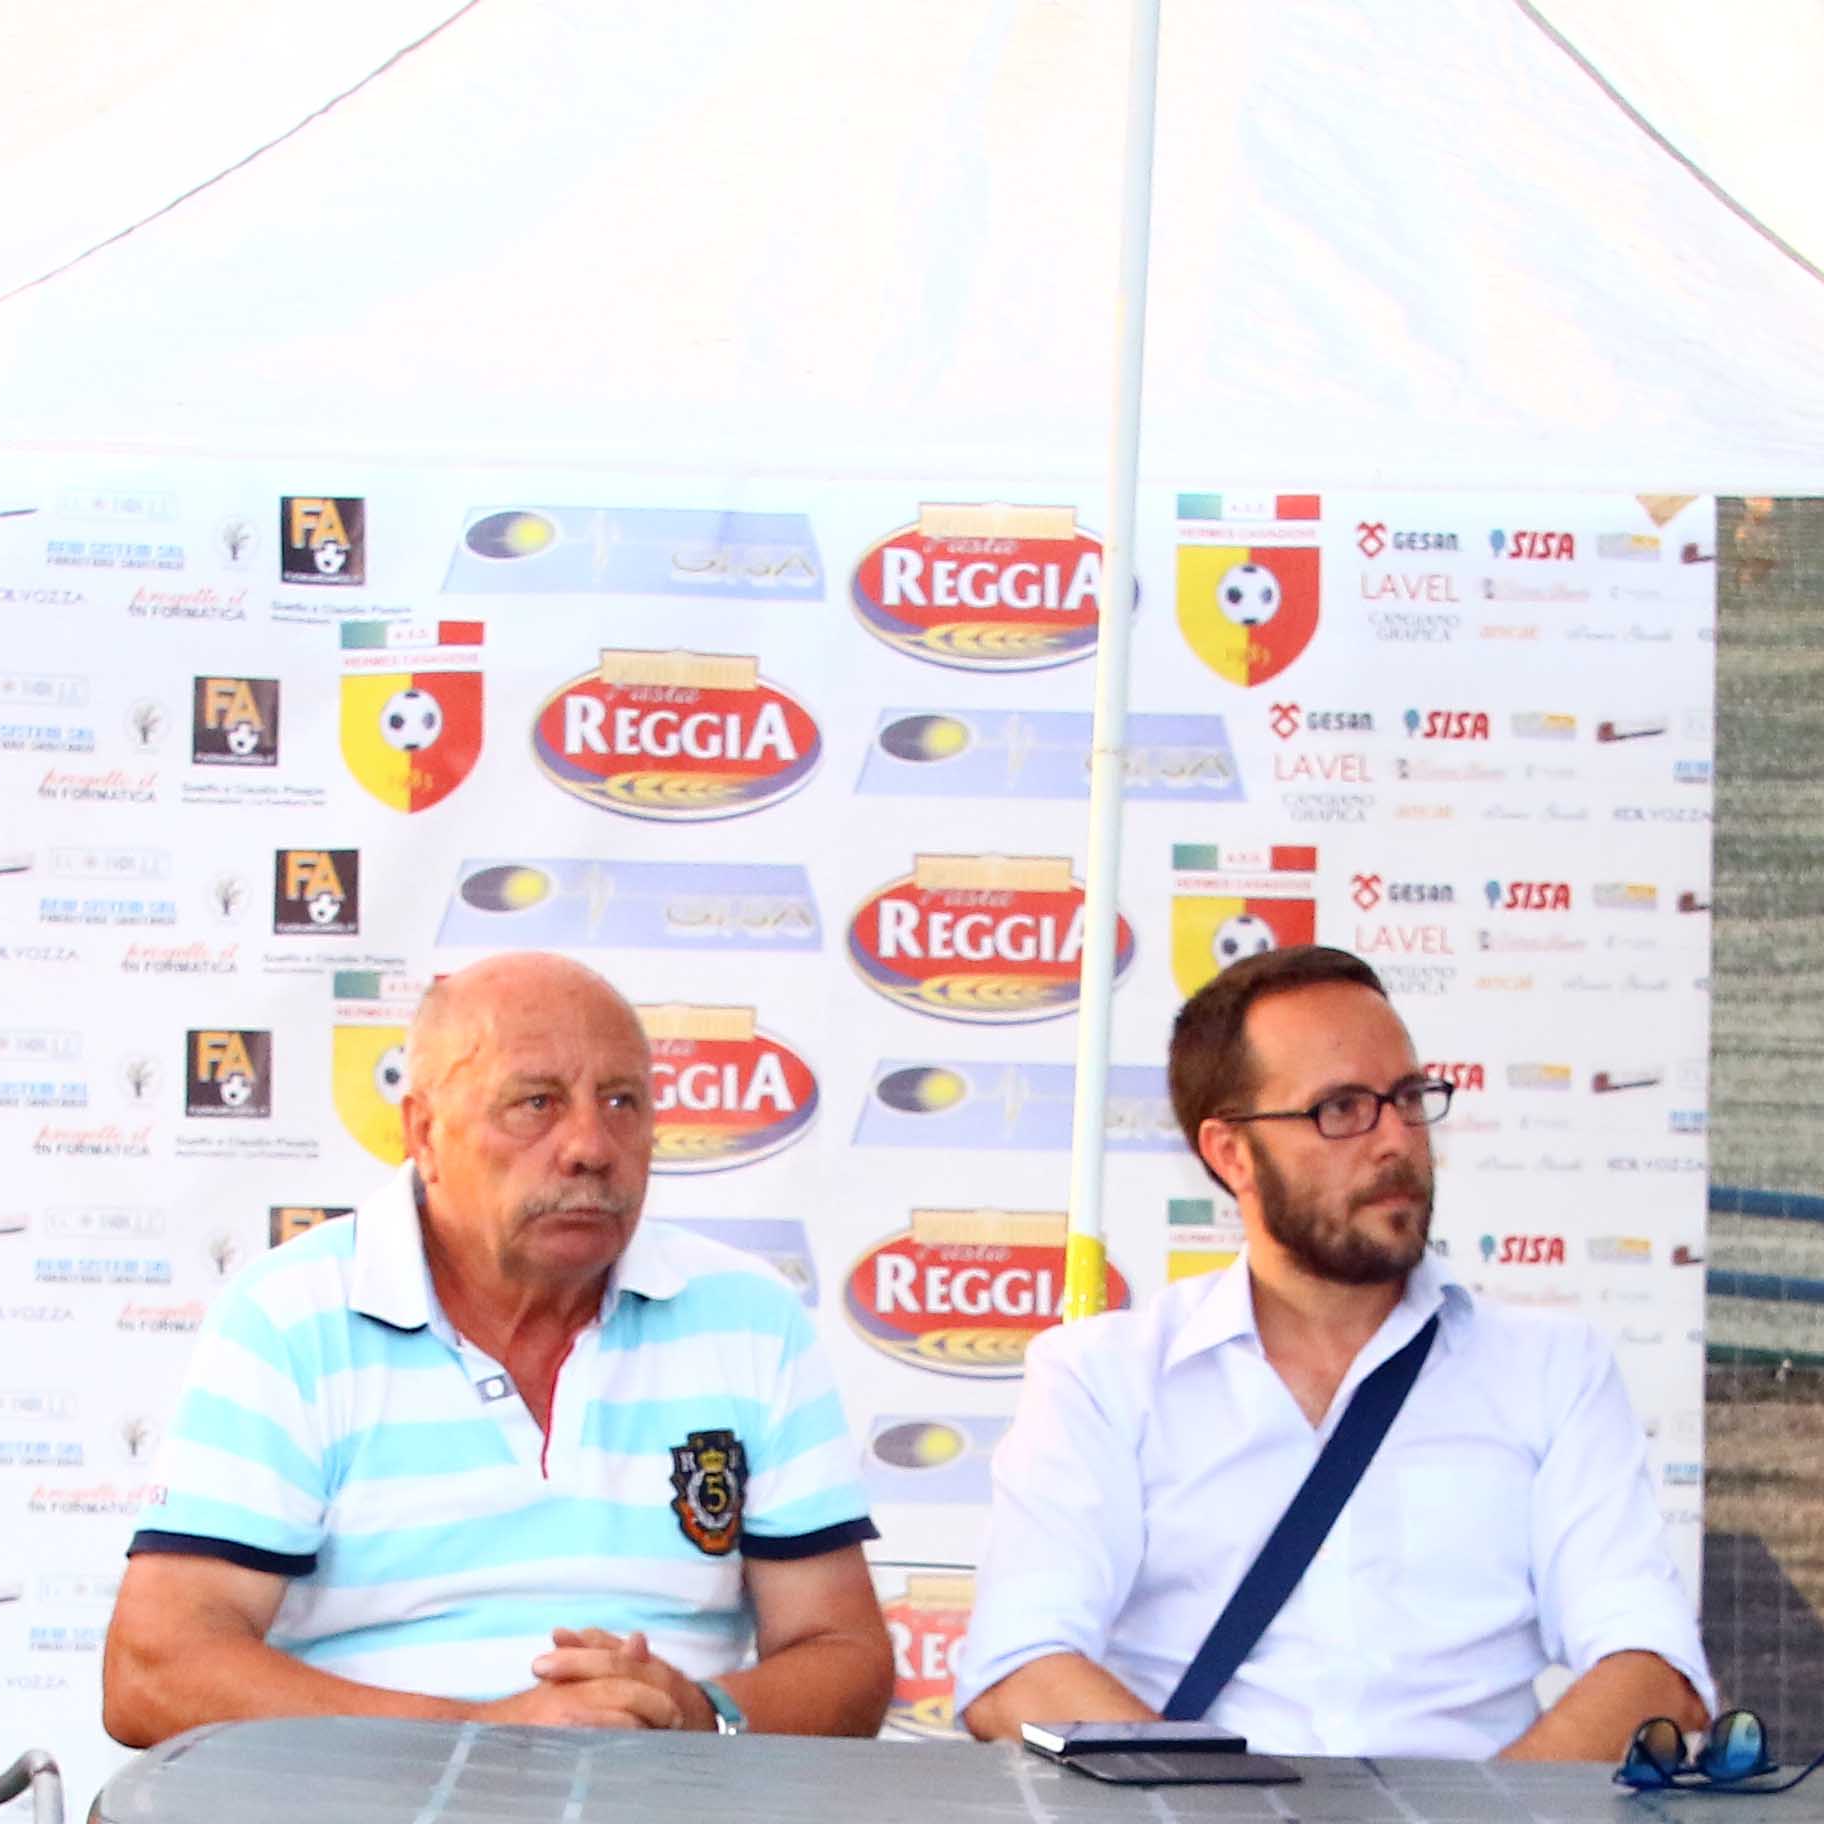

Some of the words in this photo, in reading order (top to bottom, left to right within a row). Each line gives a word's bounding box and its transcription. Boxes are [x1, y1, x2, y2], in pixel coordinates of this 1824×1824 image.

[1509, 530, 1576, 560] SISA
[881, 547, 1104, 610] REGGIA
[1361, 573, 1460, 602] LAVEL
[563, 695, 797, 761] REGGIA
[1423, 710, 1491, 740] SISA
[1273, 753, 1372, 782] LAVEL
[1504, 880, 1572, 911] SISA
[1354, 925, 1455, 955] LAVEL
[650, 1052, 796, 1112] GGIA
[1498, 1235, 1566, 1263] SISA
[875, 1253, 1068, 1317] REGGI
[705, 1473, 728, 1514] 5
